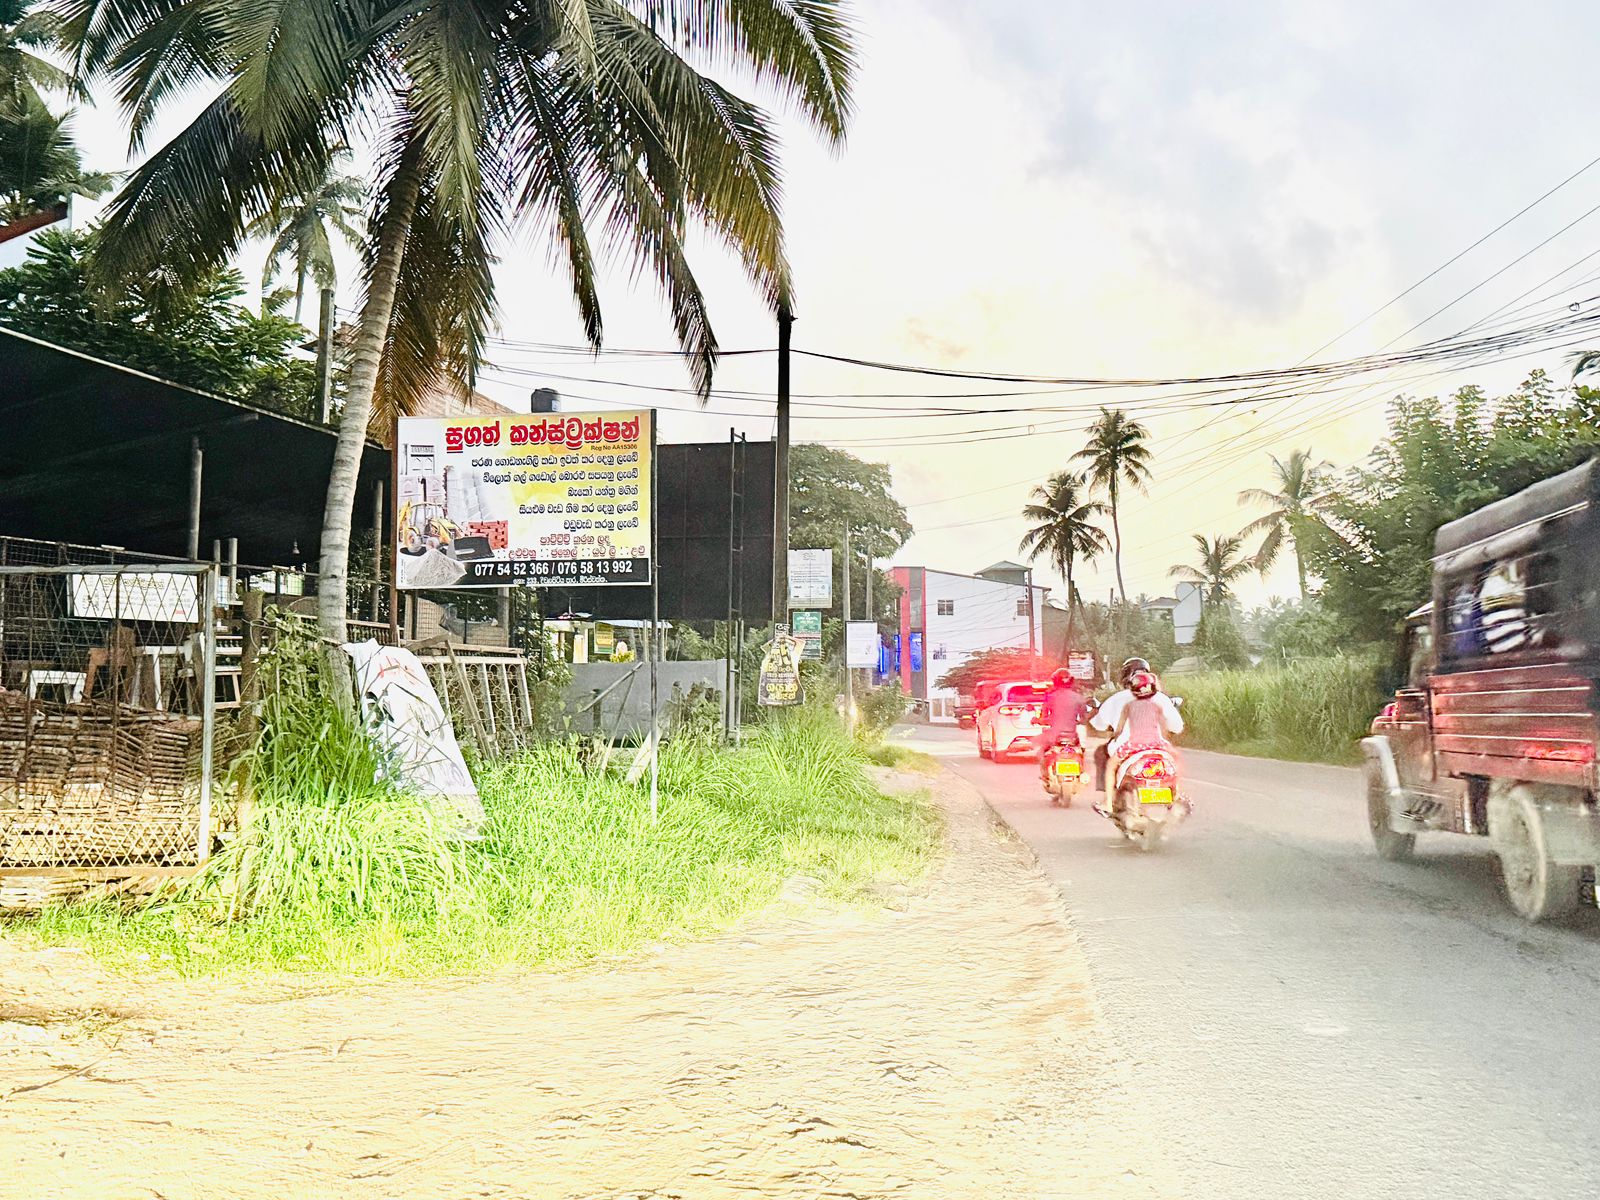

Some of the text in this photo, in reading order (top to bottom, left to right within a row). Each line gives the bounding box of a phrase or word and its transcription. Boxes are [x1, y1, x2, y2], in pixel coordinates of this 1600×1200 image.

[446, 420, 500, 452] සුගත්
[581, 454, 595, 463] කර
[617, 452, 638, 465] ලැබේ
[617, 468, 638, 481] ලැබේ
[547, 504, 563, 513] වැඩ
[582, 503, 594, 513] කර
[617, 501, 638, 514] ලැබේ
[595, 519, 614, 531] කරනු
[617, 517, 638, 530] ලැබේ
[474, 564, 494, 576] 077
[497, 563, 510, 575] 54
[513, 563, 526, 575] 52
[529, 562, 549, 575] 366
[557, 562, 577, 574] 076
[580, 561, 593, 574] 58
[597, 561, 609, 573] 13
[612, 560, 632, 573] 992
